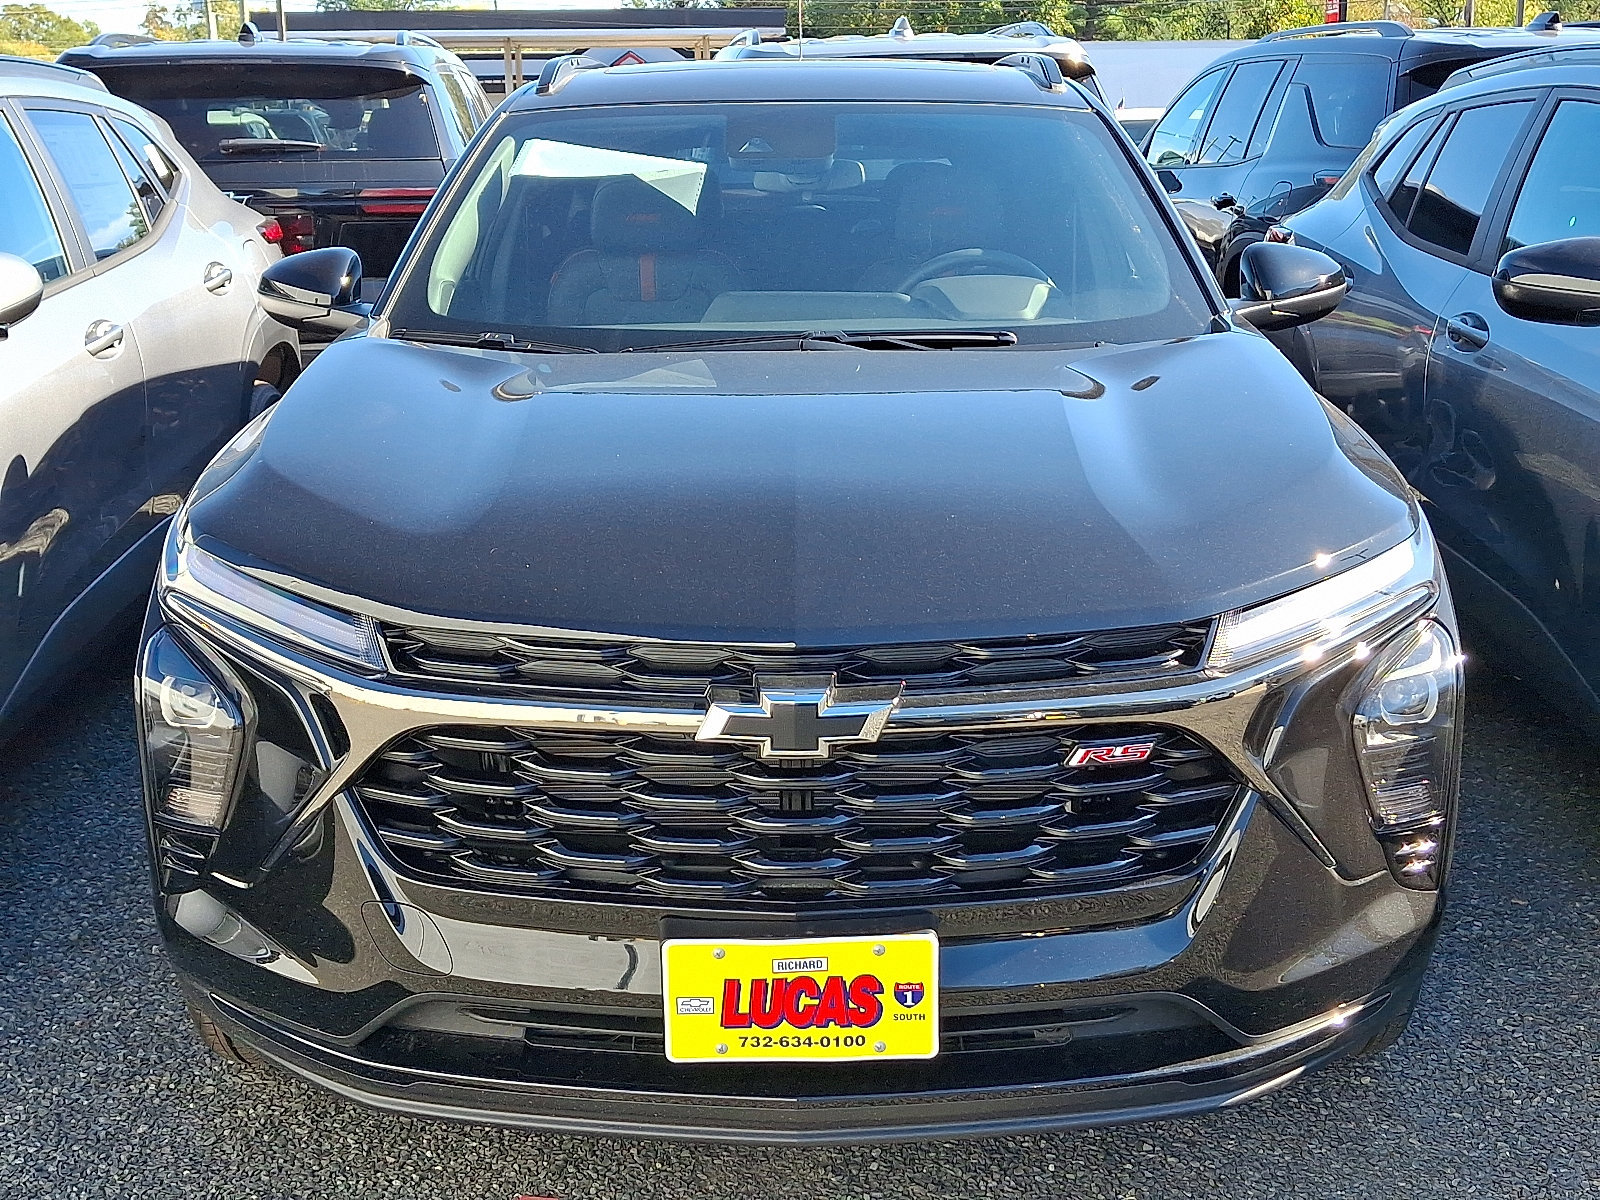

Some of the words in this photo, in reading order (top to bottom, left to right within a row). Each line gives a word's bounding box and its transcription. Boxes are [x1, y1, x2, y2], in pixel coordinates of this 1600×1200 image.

[1070, 743, 1153, 765] RS
[777, 959, 823, 971] RICHARD
[720, 974, 884, 1029] LUCAS
[903, 990, 915, 1006] 1
[893, 1013, 926, 1021] SOUTH
[738, 1035, 866, 1048] 732-634-0100
